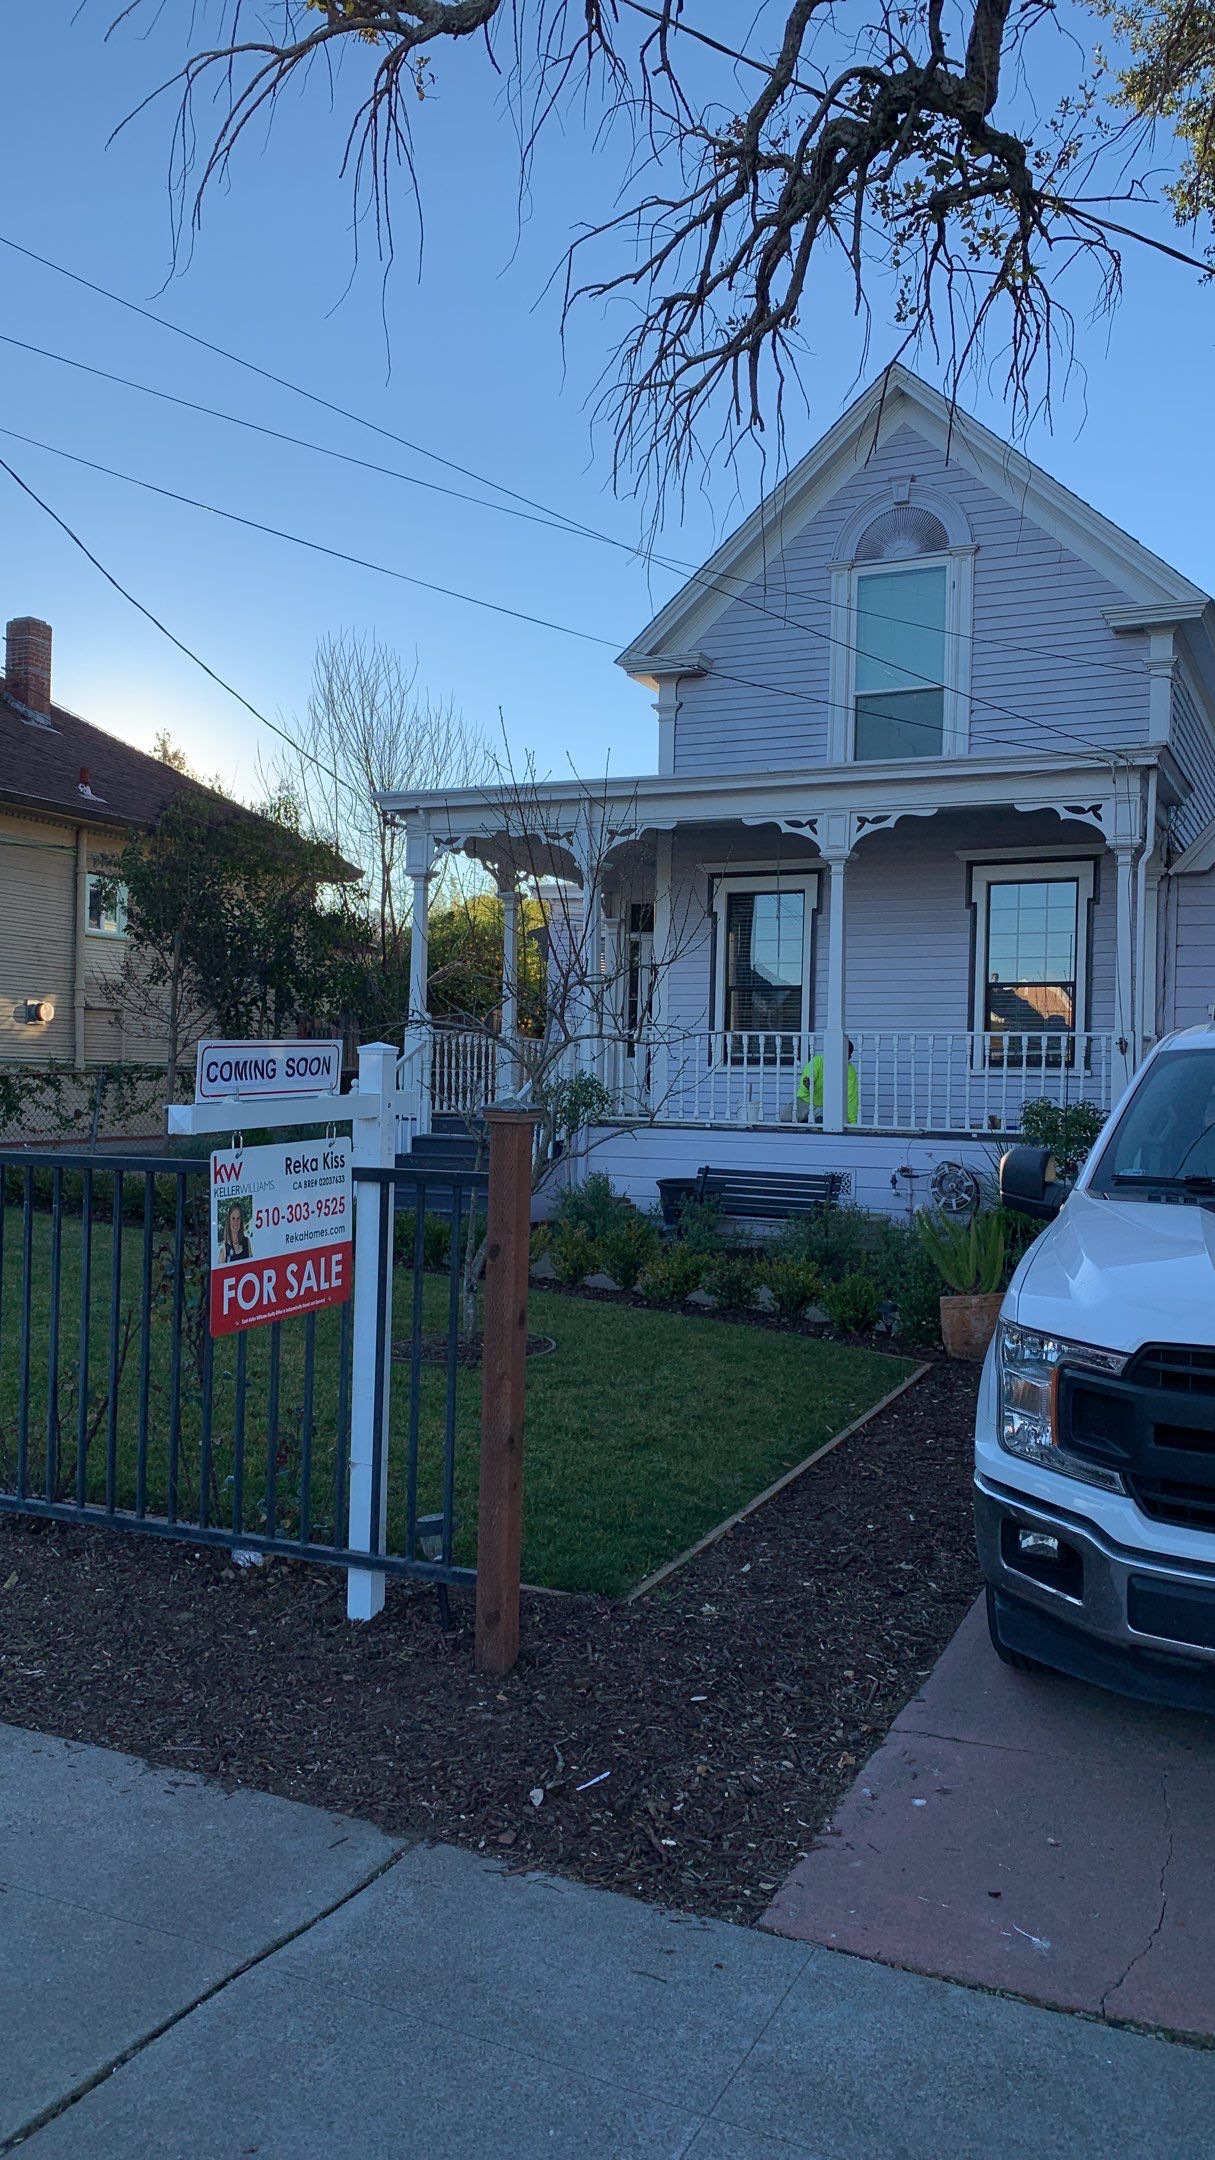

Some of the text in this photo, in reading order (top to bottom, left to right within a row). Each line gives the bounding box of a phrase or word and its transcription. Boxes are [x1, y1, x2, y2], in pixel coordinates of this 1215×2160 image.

[206, 1056, 331, 1083] COMING SOON
[285, 1151, 346, 1175] Reka Kiss
[292, 1181, 303, 1190] CA
[255, 1195, 346, 1229] 510-303-9525
[285, 1224, 346, 1244] RekaHomes.com
[223, 1269, 277, 1315] FOR
[285, 1253, 343, 1299] SALE
